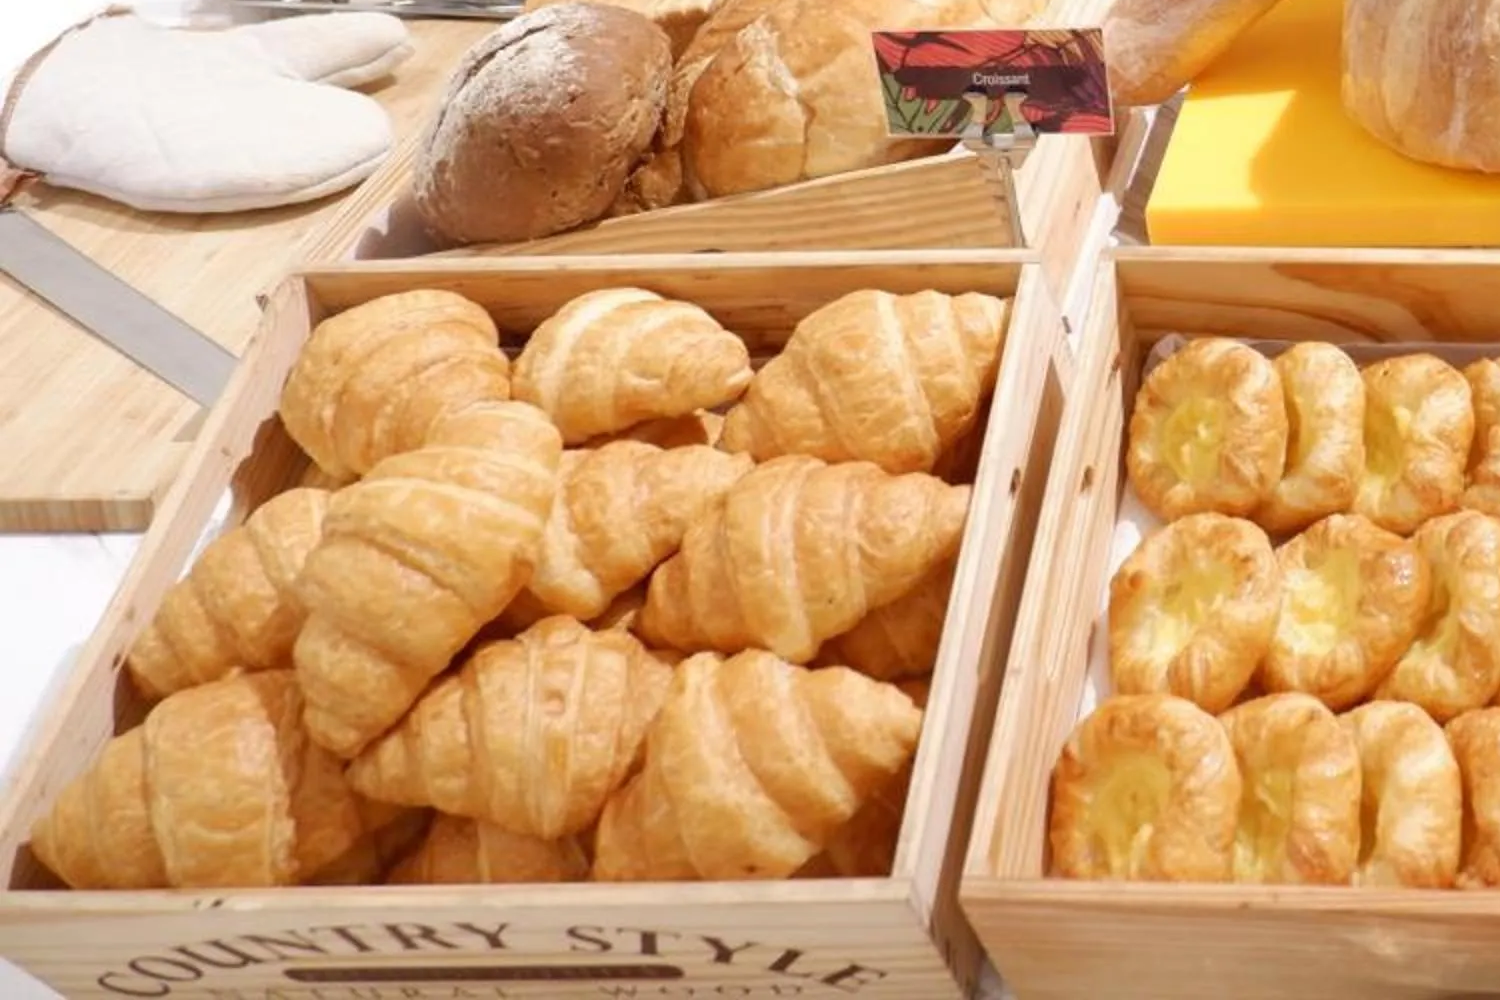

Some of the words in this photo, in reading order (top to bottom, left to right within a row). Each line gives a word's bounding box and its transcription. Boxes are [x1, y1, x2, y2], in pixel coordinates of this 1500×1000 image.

[973, 72, 1030, 85] Croissant
[97, 922, 508, 997] COUNTRY
[566, 924, 889, 993] STYLE
